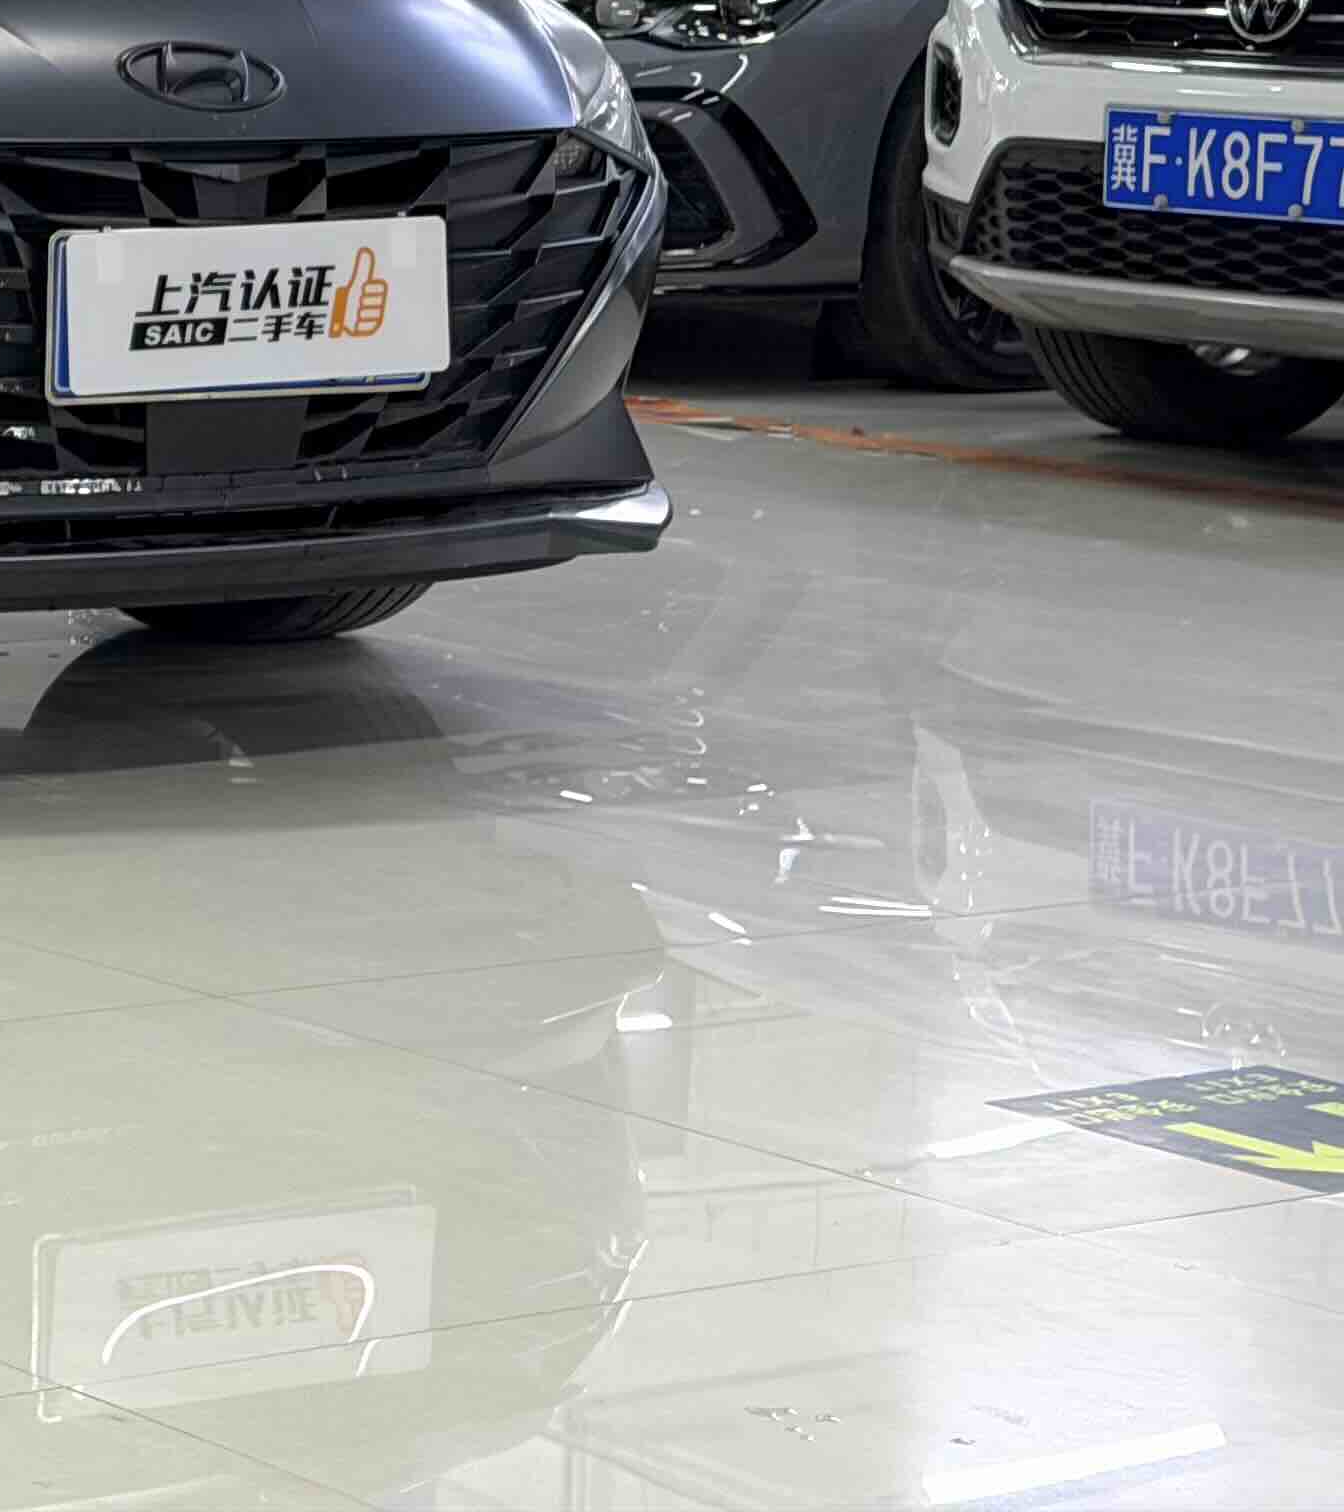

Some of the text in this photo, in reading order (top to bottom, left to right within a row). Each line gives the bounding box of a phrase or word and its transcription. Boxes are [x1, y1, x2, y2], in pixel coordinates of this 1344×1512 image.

[134, 265, 336, 318] 上汽认证
[143, 311, 328, 346] SAIC 二手车
